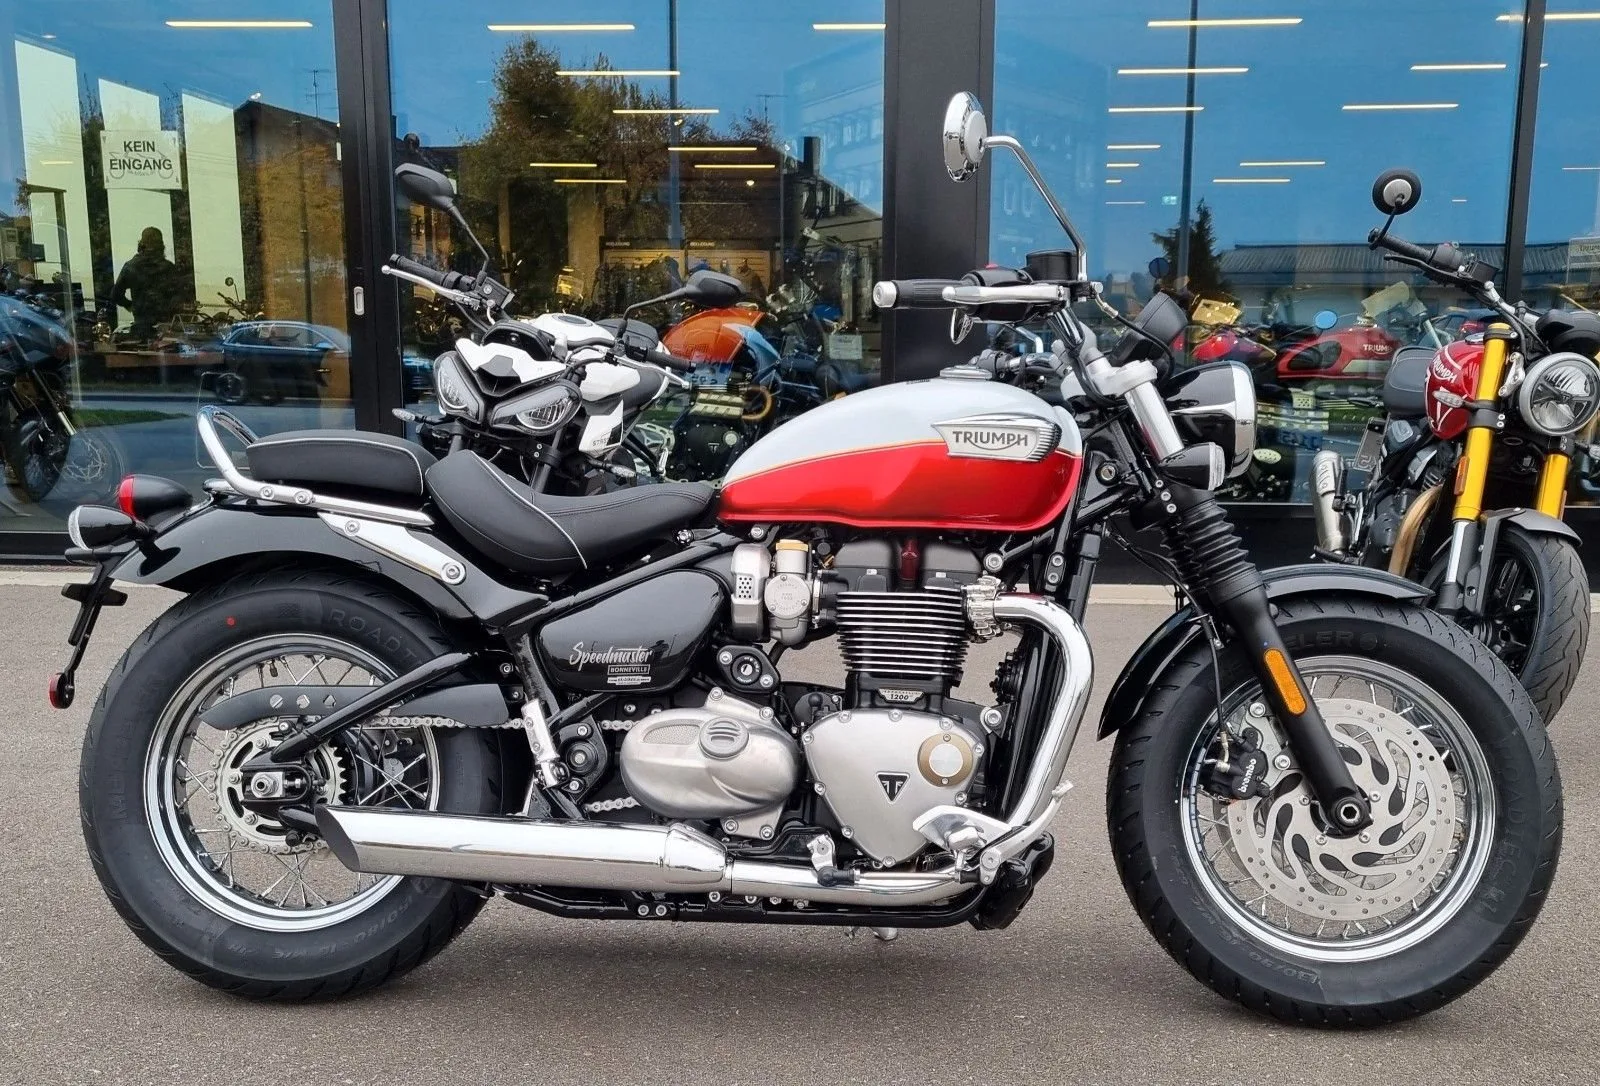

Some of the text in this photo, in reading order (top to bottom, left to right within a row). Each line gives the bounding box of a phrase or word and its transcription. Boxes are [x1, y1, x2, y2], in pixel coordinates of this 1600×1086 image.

[123, 141, 155, 152] KEIN
[110, 159, 172, 170] EINGANG
[952, 430, 1028, 451] TRIUMPH
[569, 641, 653, 671] Speedmaster
[1237, 758, 1257, 793] brembo
